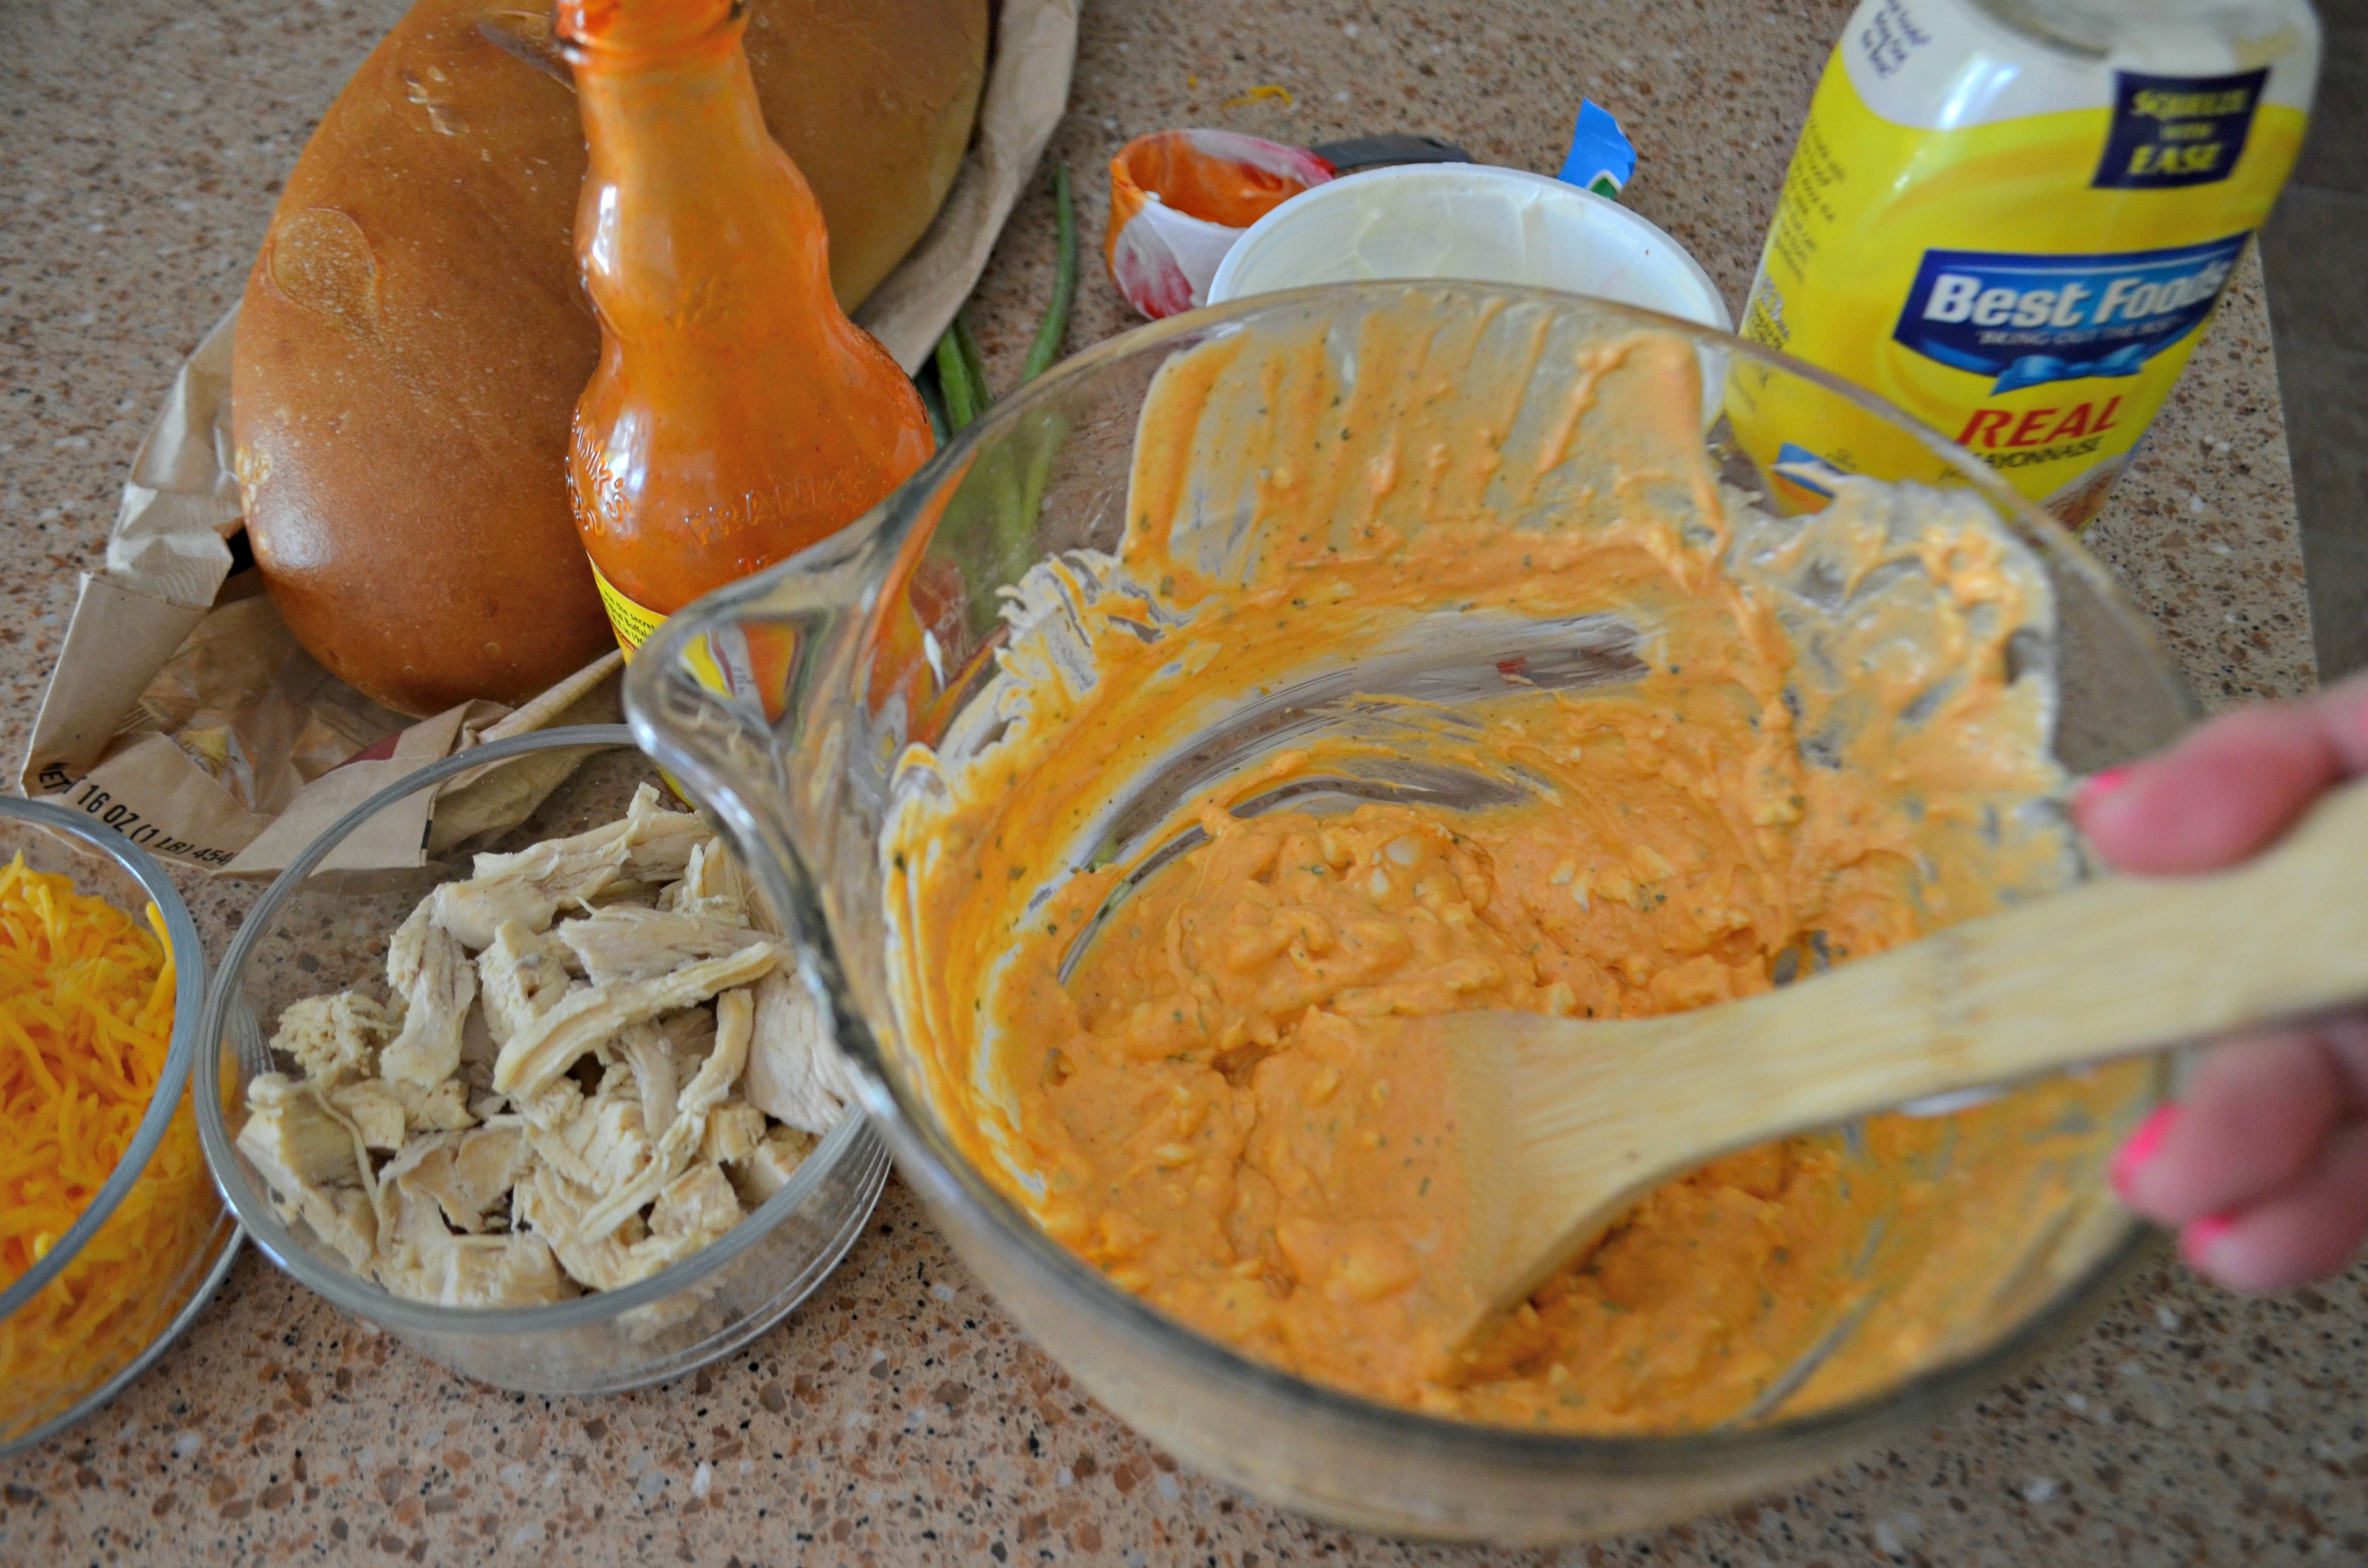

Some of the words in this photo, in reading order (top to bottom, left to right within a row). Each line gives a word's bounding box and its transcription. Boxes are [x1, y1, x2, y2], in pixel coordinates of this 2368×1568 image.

[2125, 143, 2224, 176] EASE
[1923, 273, 2091, 328] Best
[1954, 395, 2123, 449] REAL
[624, 617, 648, 637] Buffal
[630, 614, 656, 632] secret
[78, 784, 111, 814] 16
[103, 804, 140, 833] OZ
[129, 823, 160, 843] (1
[154, 836, 195, 854] LB)
